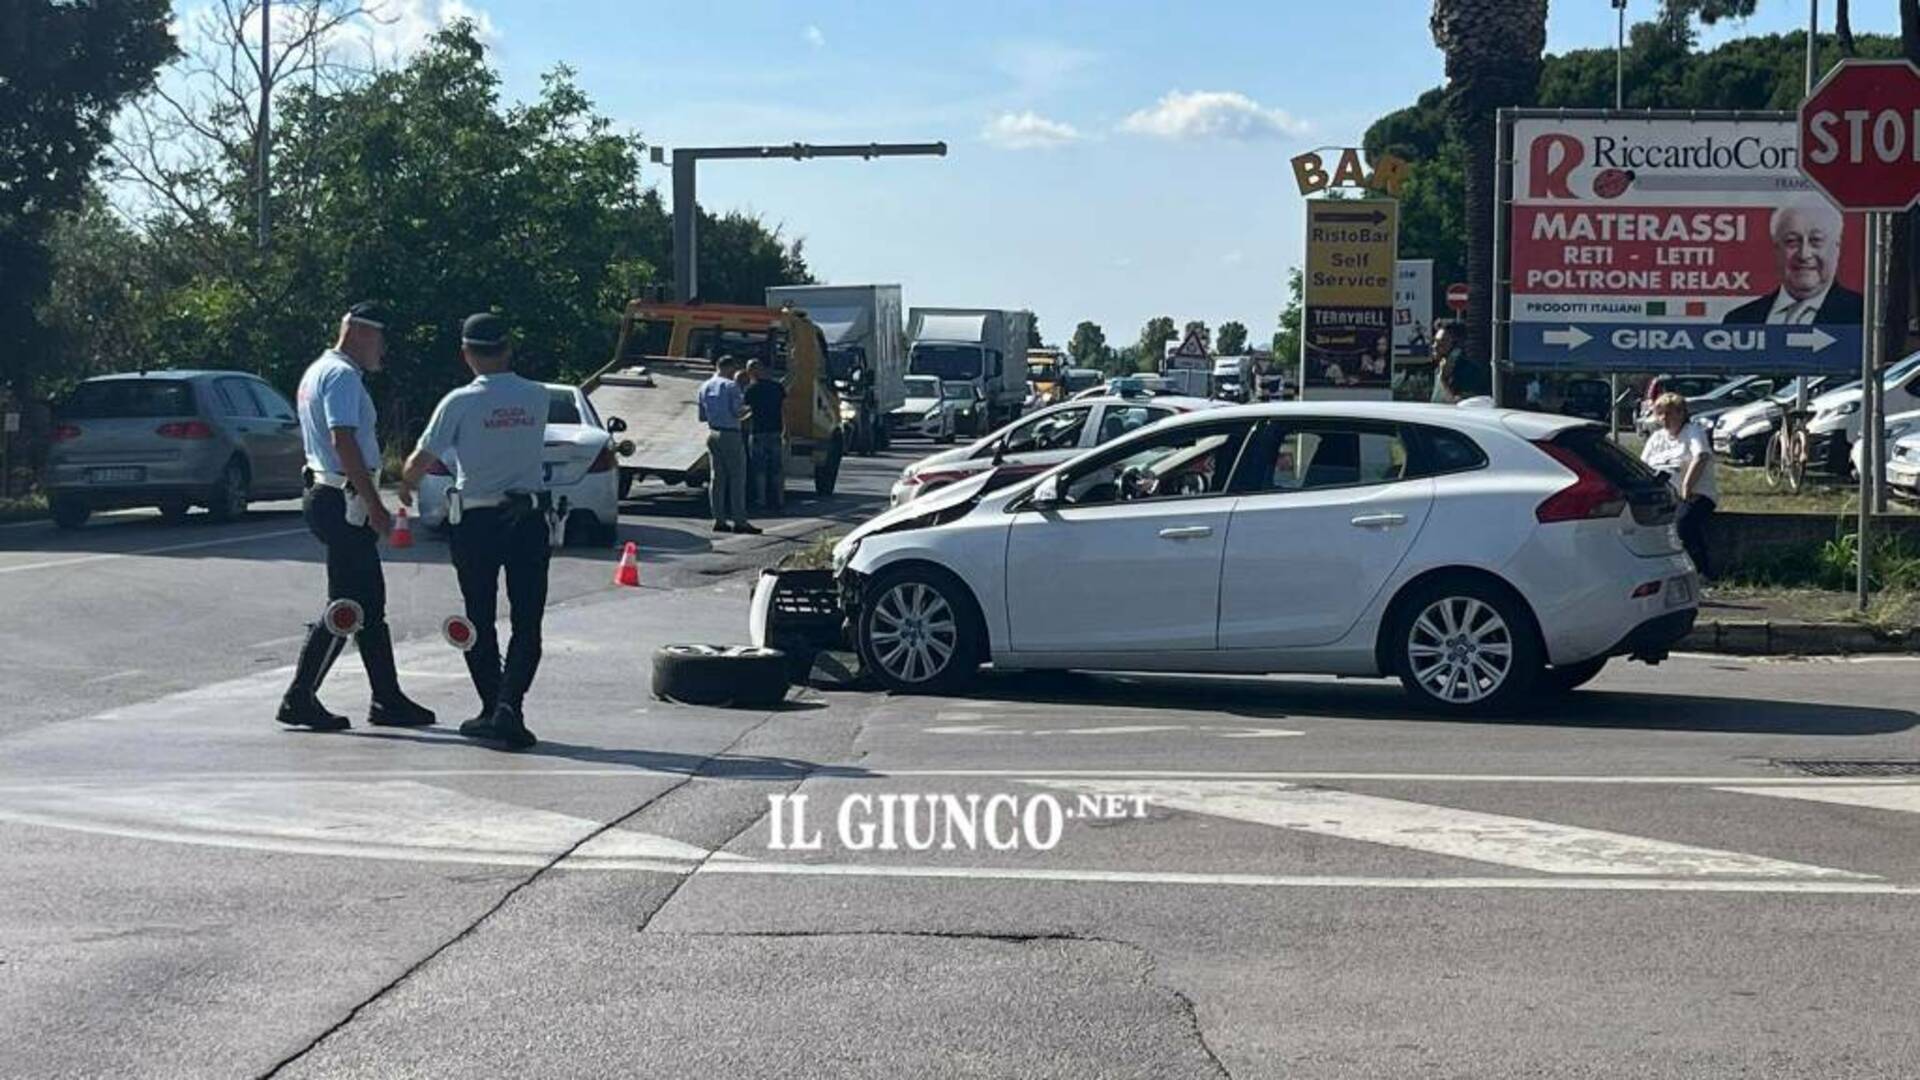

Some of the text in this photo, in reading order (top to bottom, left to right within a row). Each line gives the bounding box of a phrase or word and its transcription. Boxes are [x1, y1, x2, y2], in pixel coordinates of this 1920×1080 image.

[1592, 135, 1799, 169] RiccardoCor
[1290, 147, 1411, 197] BAR
[1312, 228, 1389, 242] RistoBar
[1531, 212, 1747, 242] MATERASSI
[1331, 252, 1369, 268] Self
[1563, 245, 1613, 265] RETI
[1656, 247, 1714, 266] LETTI
[1312, 271, 1388, 288] Service
[1527, 269, 1751, 290] POLTRONE RELAX
[1527, 302, 1642, 314] PRODOTTI ITALIANI
[1611, 329, 1766, 351] GIRA QUI
